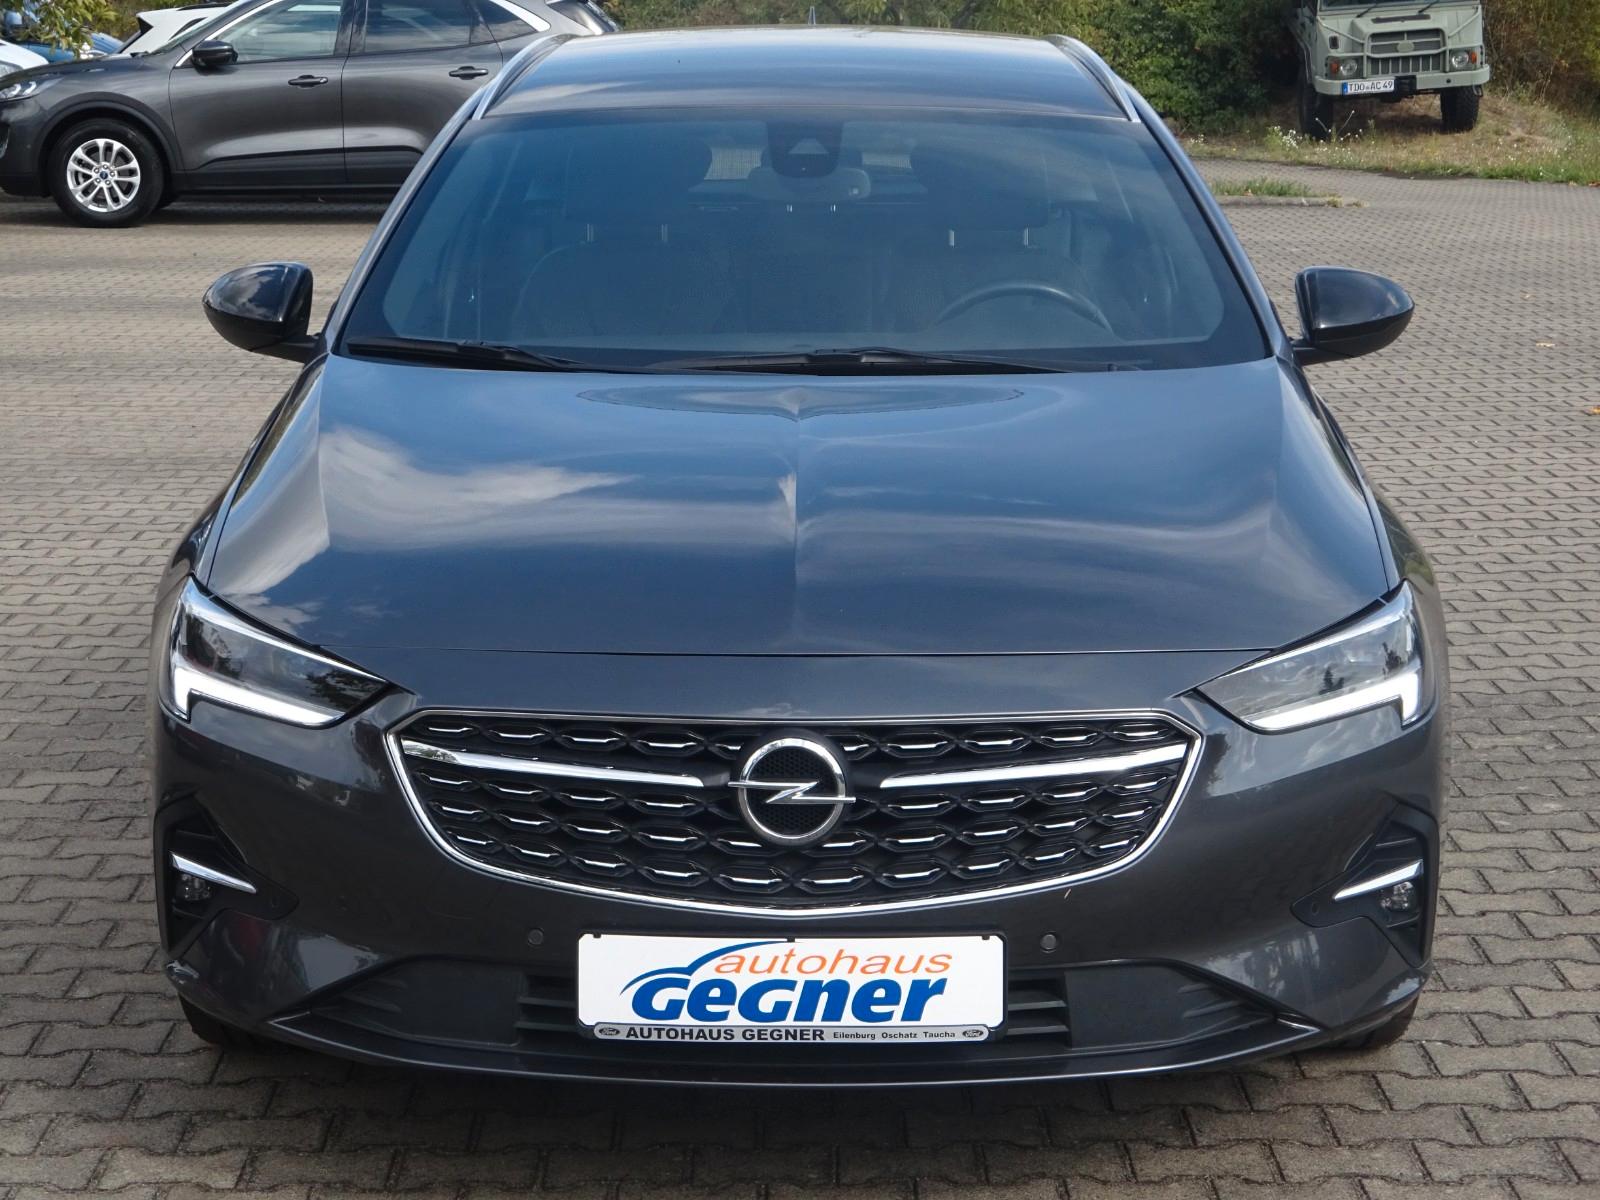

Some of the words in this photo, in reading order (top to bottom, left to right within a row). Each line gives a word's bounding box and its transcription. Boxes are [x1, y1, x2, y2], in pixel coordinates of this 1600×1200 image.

[714, 948, 952, 974] autohaus
[626, 1027, 735, 1041] AUTOHAUS
[742, 1028, 825, 1041] GEGNER
[833, 1032, 877, 1041] Eilenburg
[881, 1032, 918, 1040] Oschatz
[922, 1031, 956, 1039] Taucha
